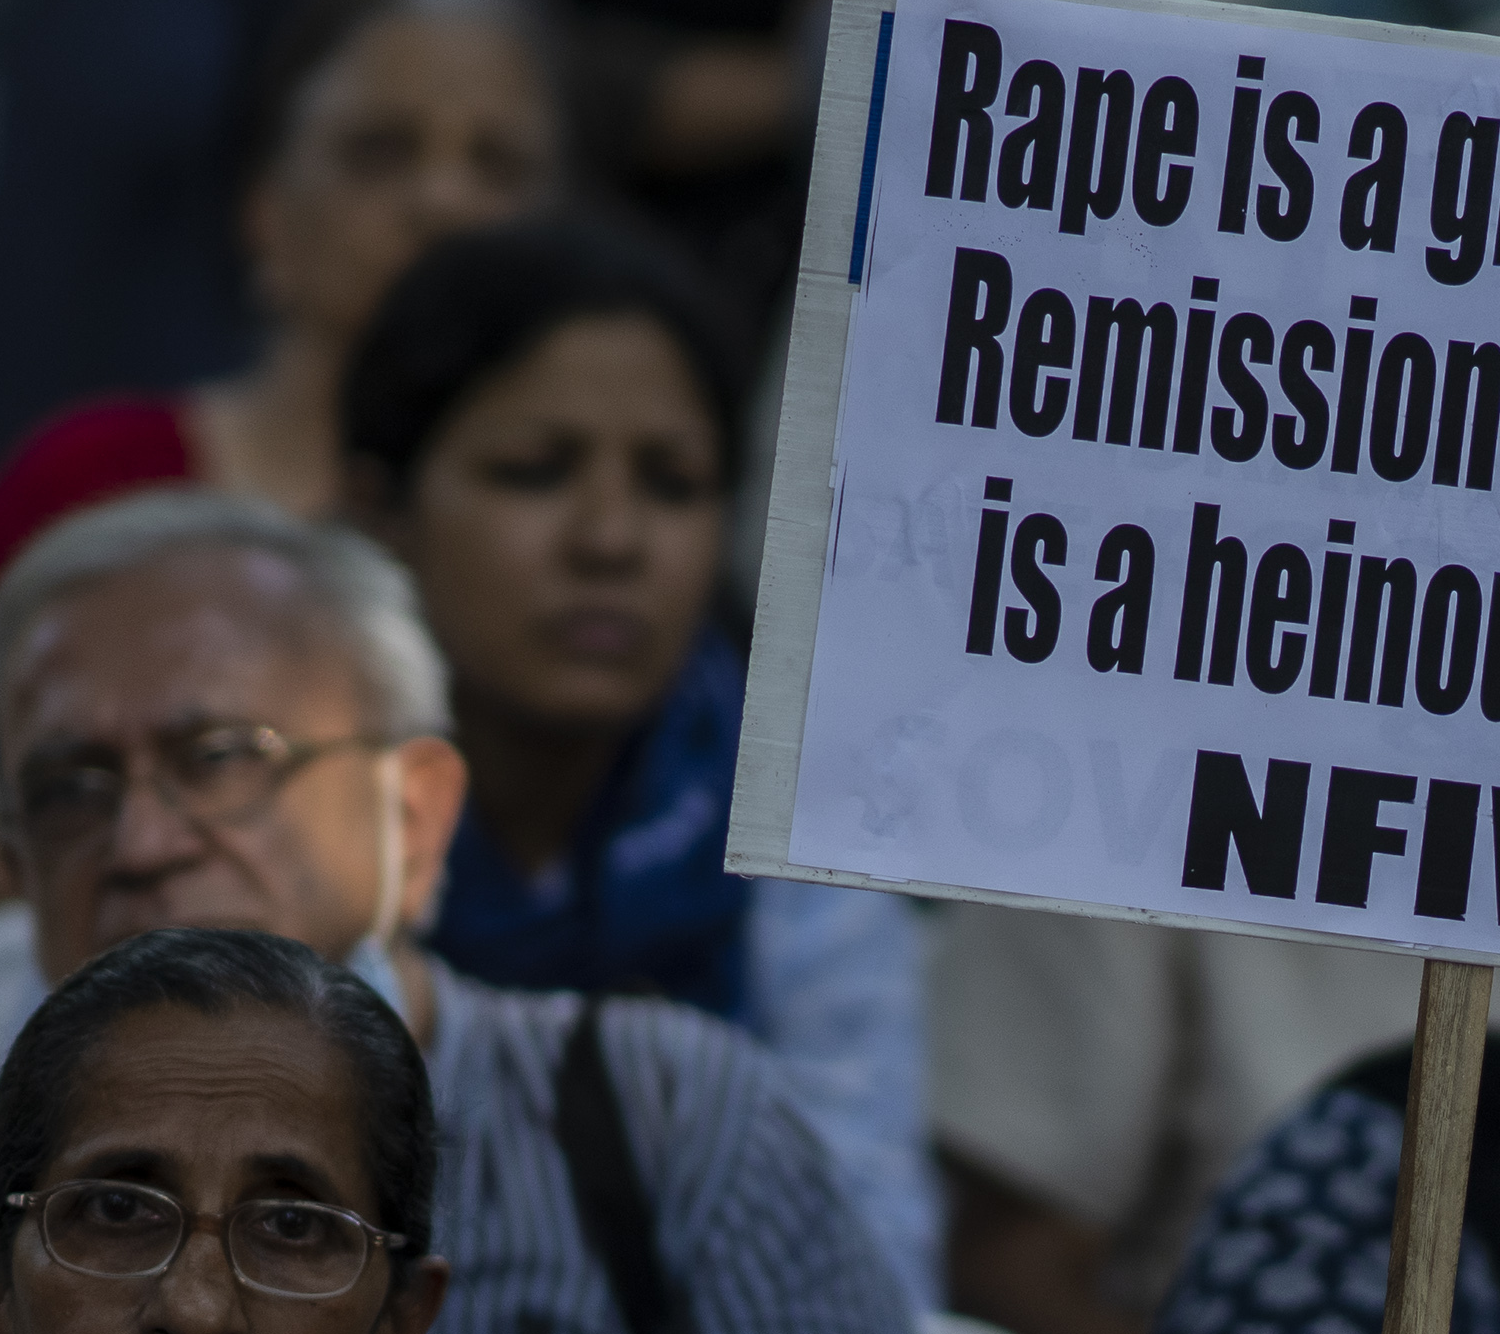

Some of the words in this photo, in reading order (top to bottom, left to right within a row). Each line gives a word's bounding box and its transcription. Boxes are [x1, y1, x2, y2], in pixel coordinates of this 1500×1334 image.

[925, 19, 1199, 235] Rape
[1218, 55, 1320, 242] is
[1340, 102, 1407, 253] a
[966, 476, 1067, 663] is
[1087, 524, 1155, 675] a
